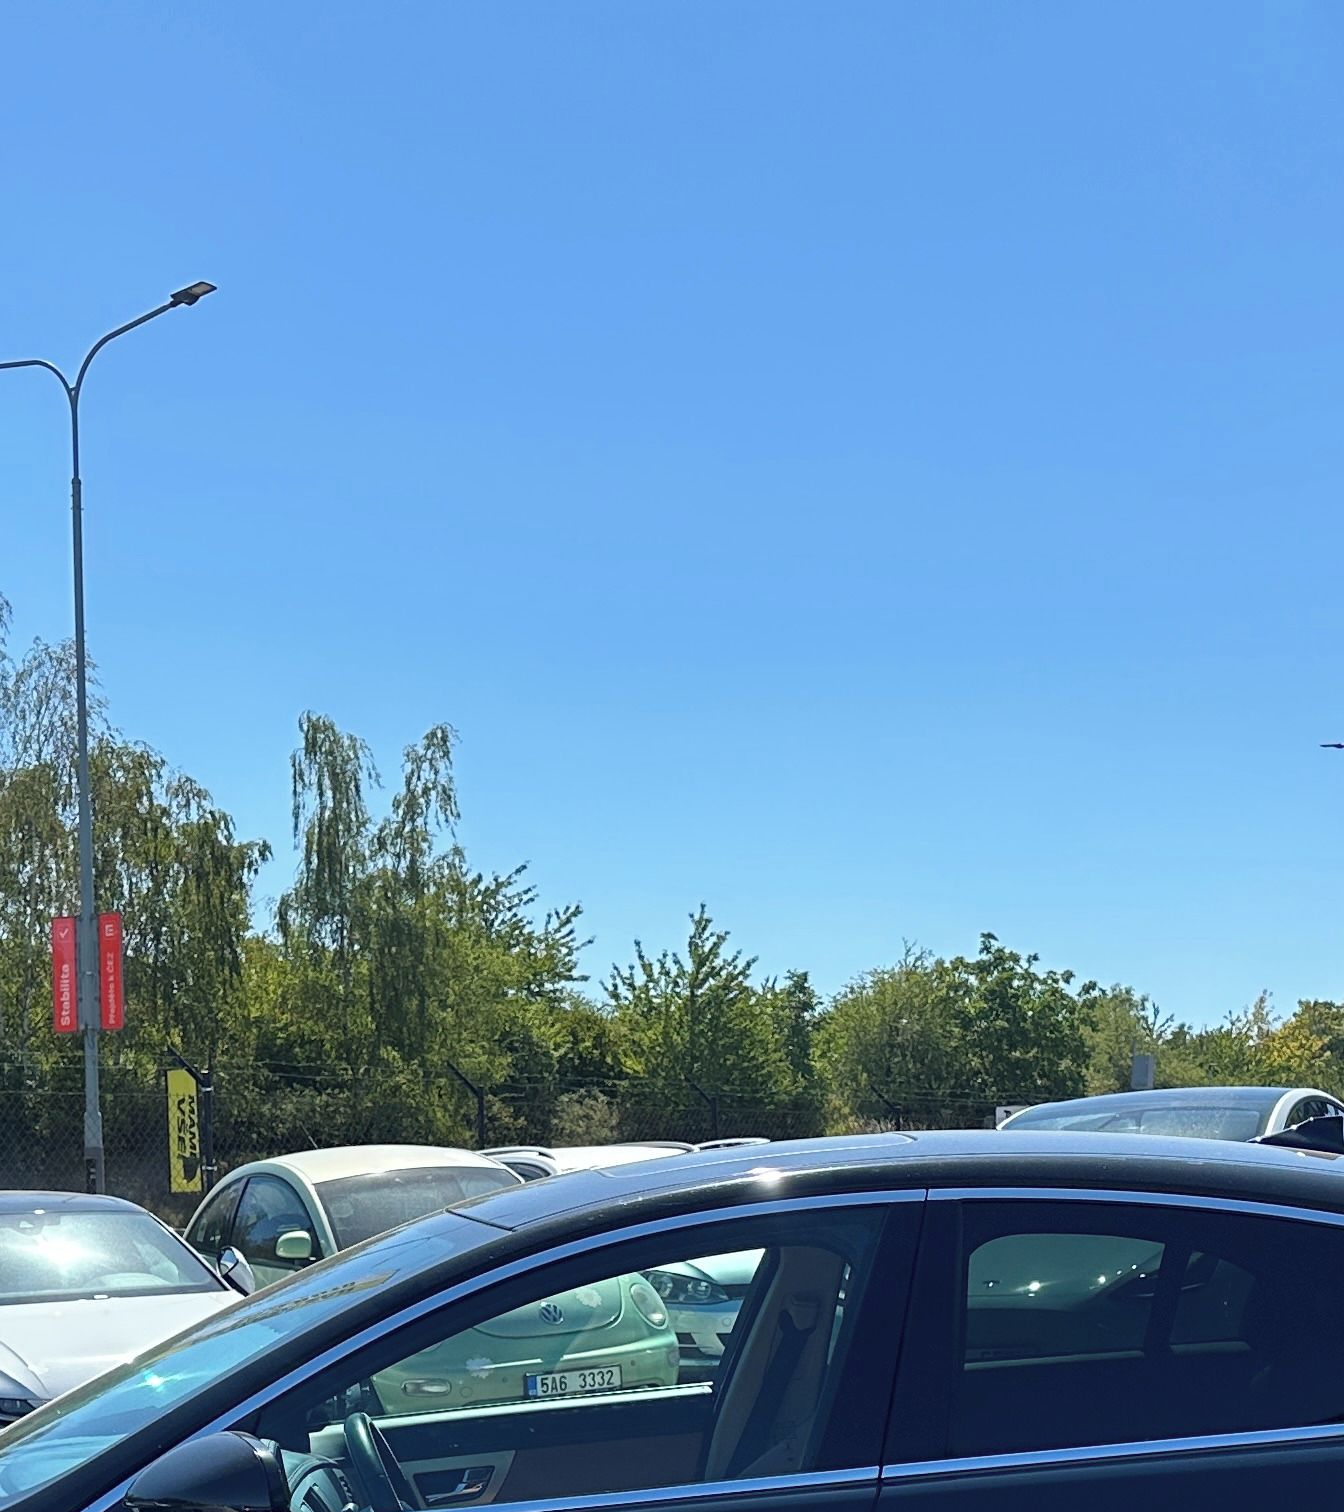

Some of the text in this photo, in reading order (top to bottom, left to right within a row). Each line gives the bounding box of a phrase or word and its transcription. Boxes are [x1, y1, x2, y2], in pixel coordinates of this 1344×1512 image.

[59, 964, 71, 1027] Stabilita
[540, 1369, 615, 1394] 5A6 3332
